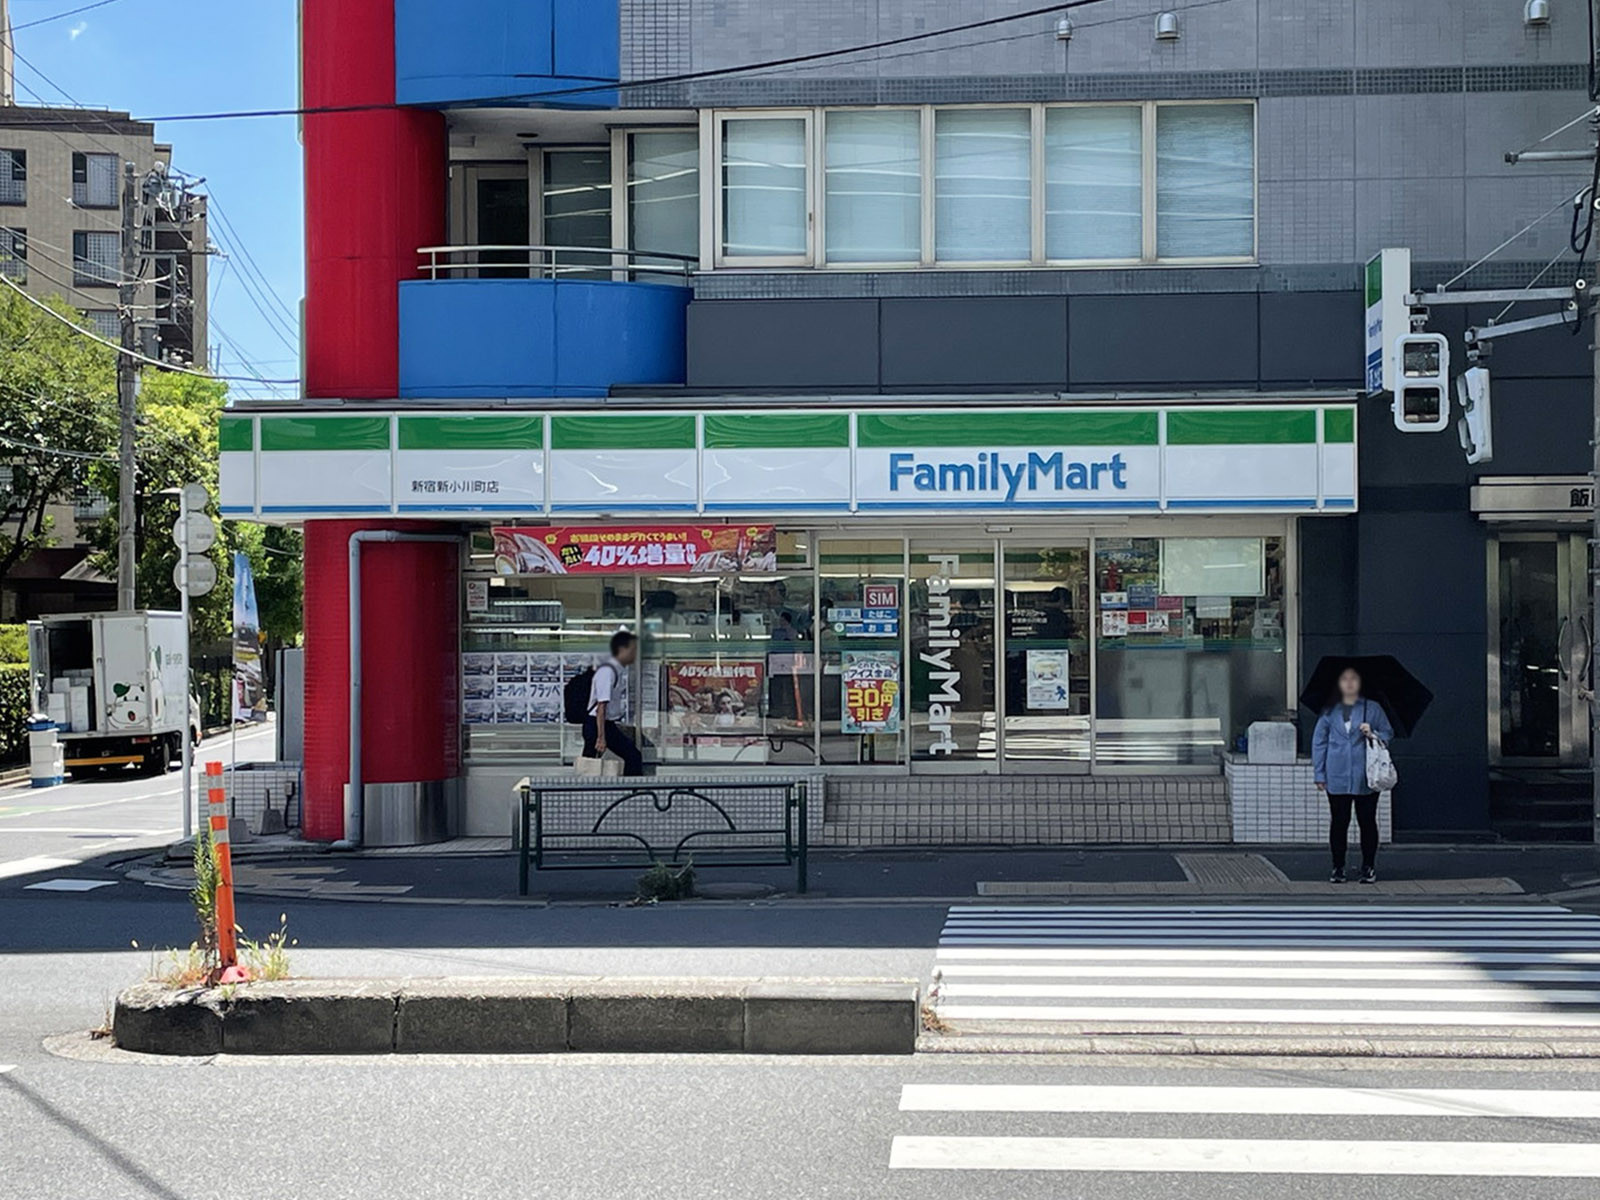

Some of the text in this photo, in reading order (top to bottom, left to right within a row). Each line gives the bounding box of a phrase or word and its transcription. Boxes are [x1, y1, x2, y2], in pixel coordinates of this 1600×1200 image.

[889, 452, 1128, 501] FamilyMart
[411, 480, 499, 493] 新宿新小川町店
[1570, 488, 1595, 508] 飯
[869, 592, 894, 606] SIM
[868, 610, 893, 619] たばこ
[920, 554, 961, 756] FamilyMart
[848, 688, 893, 708] 30円
[856, 707, 884, 721] 引き
